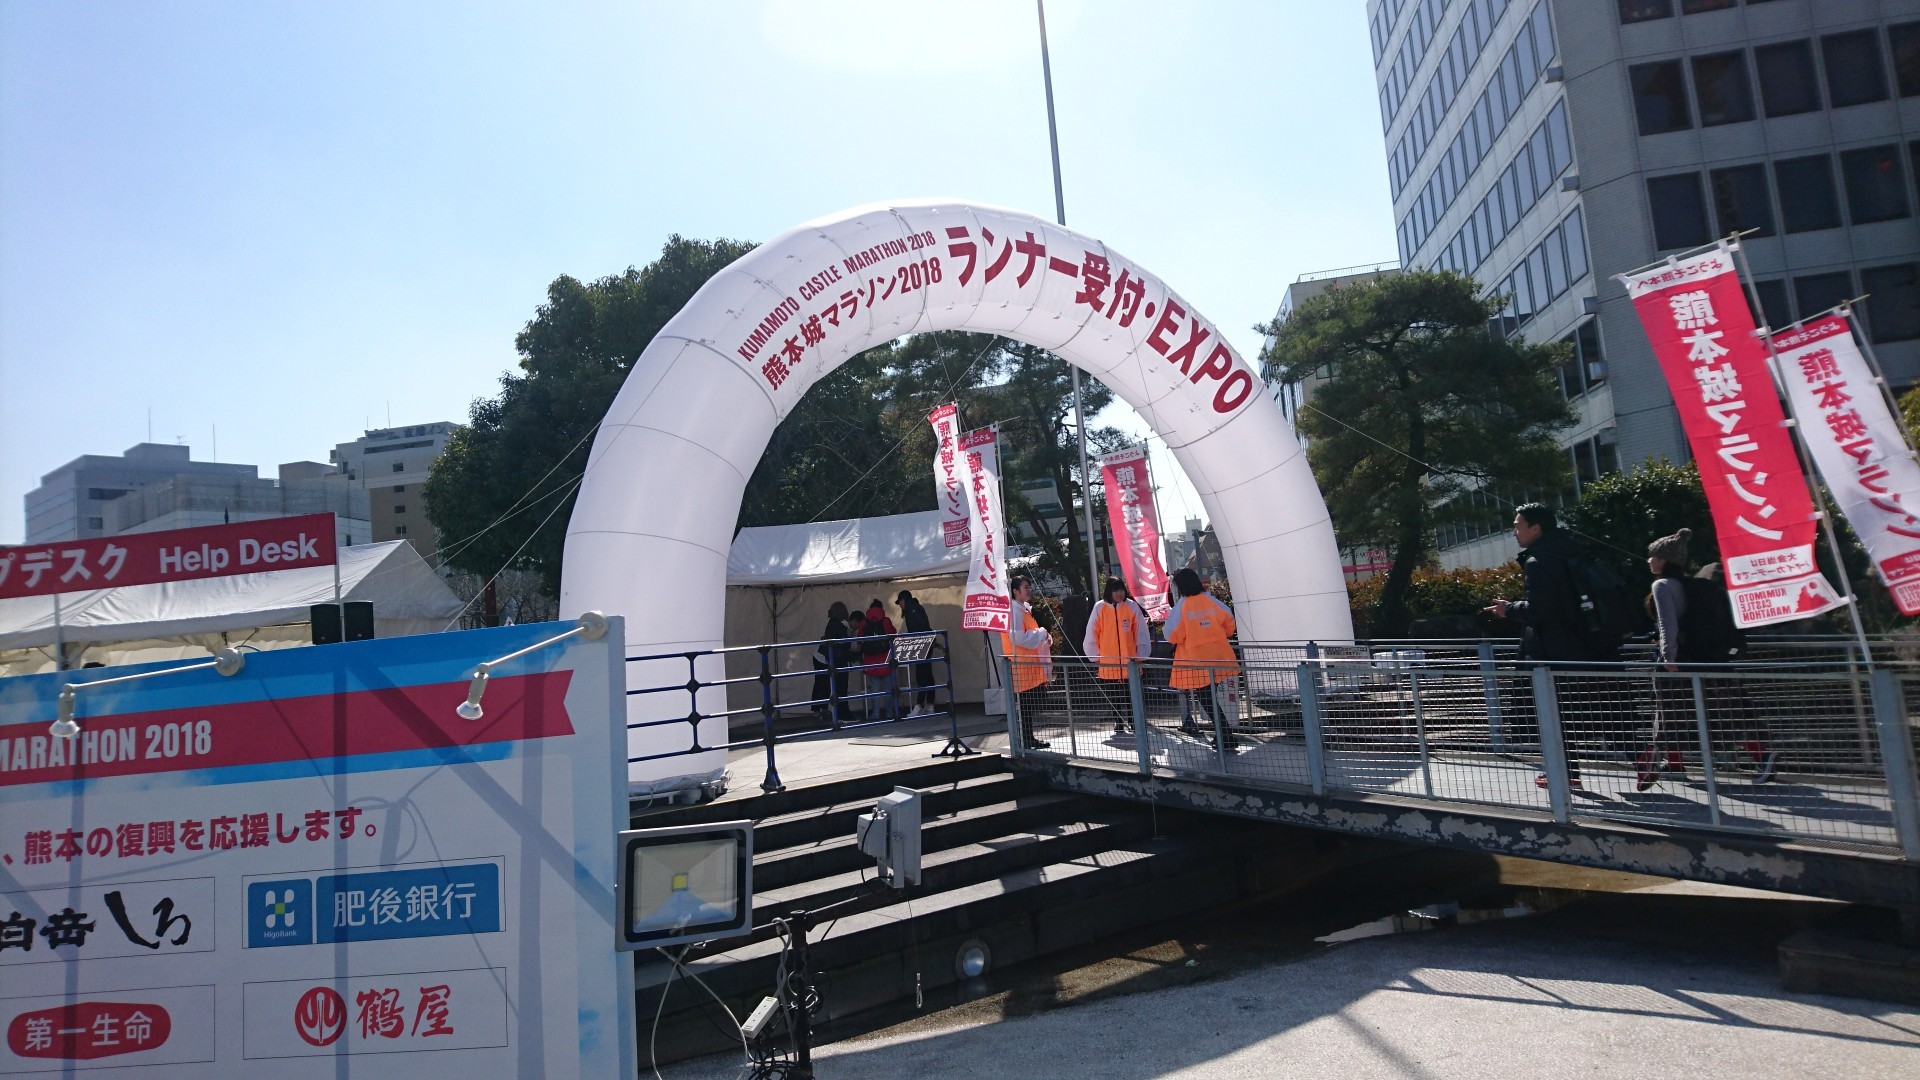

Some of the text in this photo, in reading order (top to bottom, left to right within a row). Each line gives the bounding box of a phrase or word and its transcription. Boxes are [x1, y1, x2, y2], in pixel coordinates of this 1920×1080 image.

[738, 231, 936, 362] KUMAMOTO CASTLE MARATHON 2018
[762, 257, 942, 391] 熊本城マラソン2018
[945, 226, 1252, 413] ランナー受付・EXPO
[159, 546, 230, 575] Help
[239, 533, 319, 565] Desk
[145, 720, 211, 759] 2018
[332, 884, 477, 927] 肥後銀行
[263, 930, 298, 939] HigoBank
[24, 1011, 153, 1051] 第一生命
[356, 985, 454, 1039] 鶴屋
